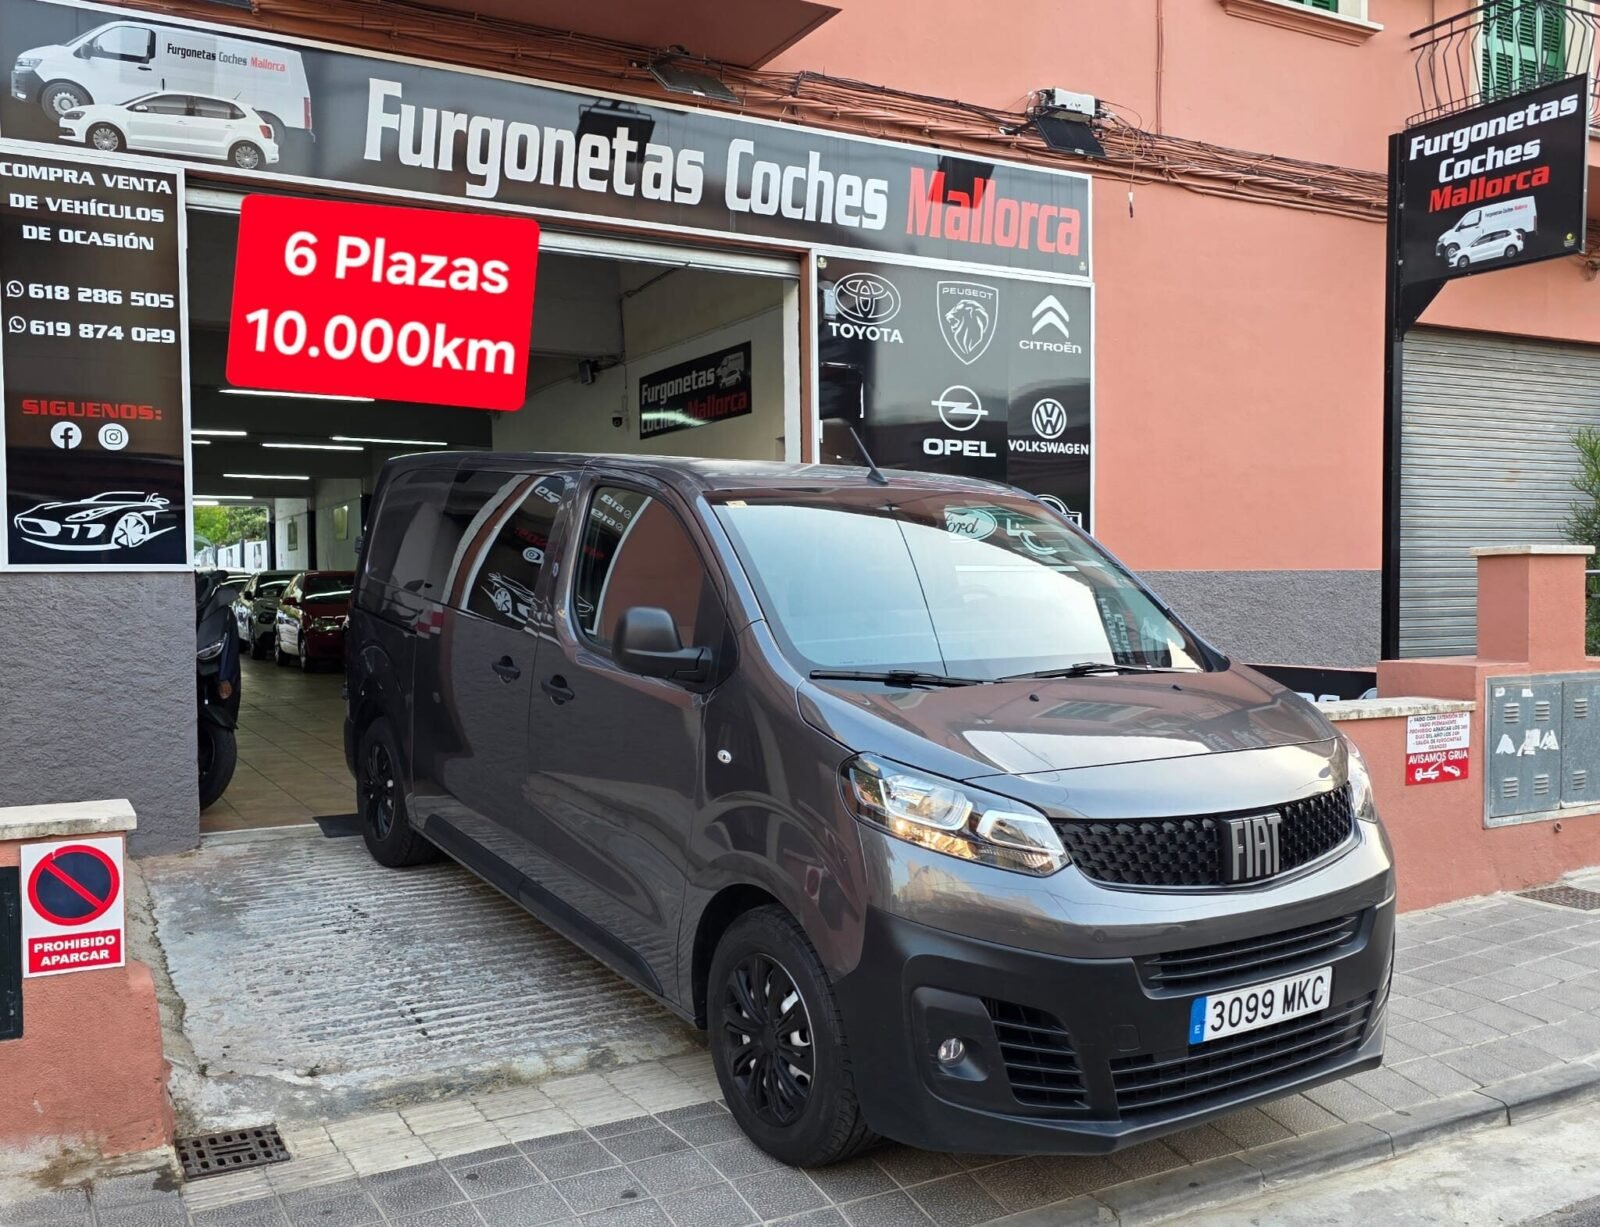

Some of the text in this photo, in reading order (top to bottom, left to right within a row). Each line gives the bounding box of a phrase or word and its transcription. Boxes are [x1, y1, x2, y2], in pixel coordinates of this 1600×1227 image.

[167, 43, 286, 72] Furgonetas Coches Mallorca
[1409, 94, 1579, 161] Furgonetas
[363, 77, 1081, 257] Furgonetas Coches Mallorca
[1438, 139, 1541, 184] Coches
[0, 162, 173, 195] COMPRA VENTA
[1428, 165, 1551, 213] Mallorca
[9, 193, 165, 223] DE VEHÍCULOS
[22, 224, 154, 251] DE OCASIÓN
[28, 283, 175, 309] 618 286 505
[942, 287, 994, 300] PEUGEOT
[29, 319, 176, 344] 619 874 029
[828, 321, 904, 344] TOYOTA
[641, 367, 715, 405] Furgonetas
[22, 399, 163, 421] SIGUENOS:
[687, 391, 748, 419] Mallorca
[922, 437, 997, 458] OPEL
[1007, 439, 1089, 456] VOLKSWAGEN
[1408, 749, 1468, 765] AVISAMOS GRUA
[1230, 813, 1281, 881] FIAT
[33, 935, 116, 953] PROHIBIDO
[40, 949, 110, 967] APARCAR
[1210, 989, 1275, 1032] 3099
[1282, 975, 1325, 1015] MKC
